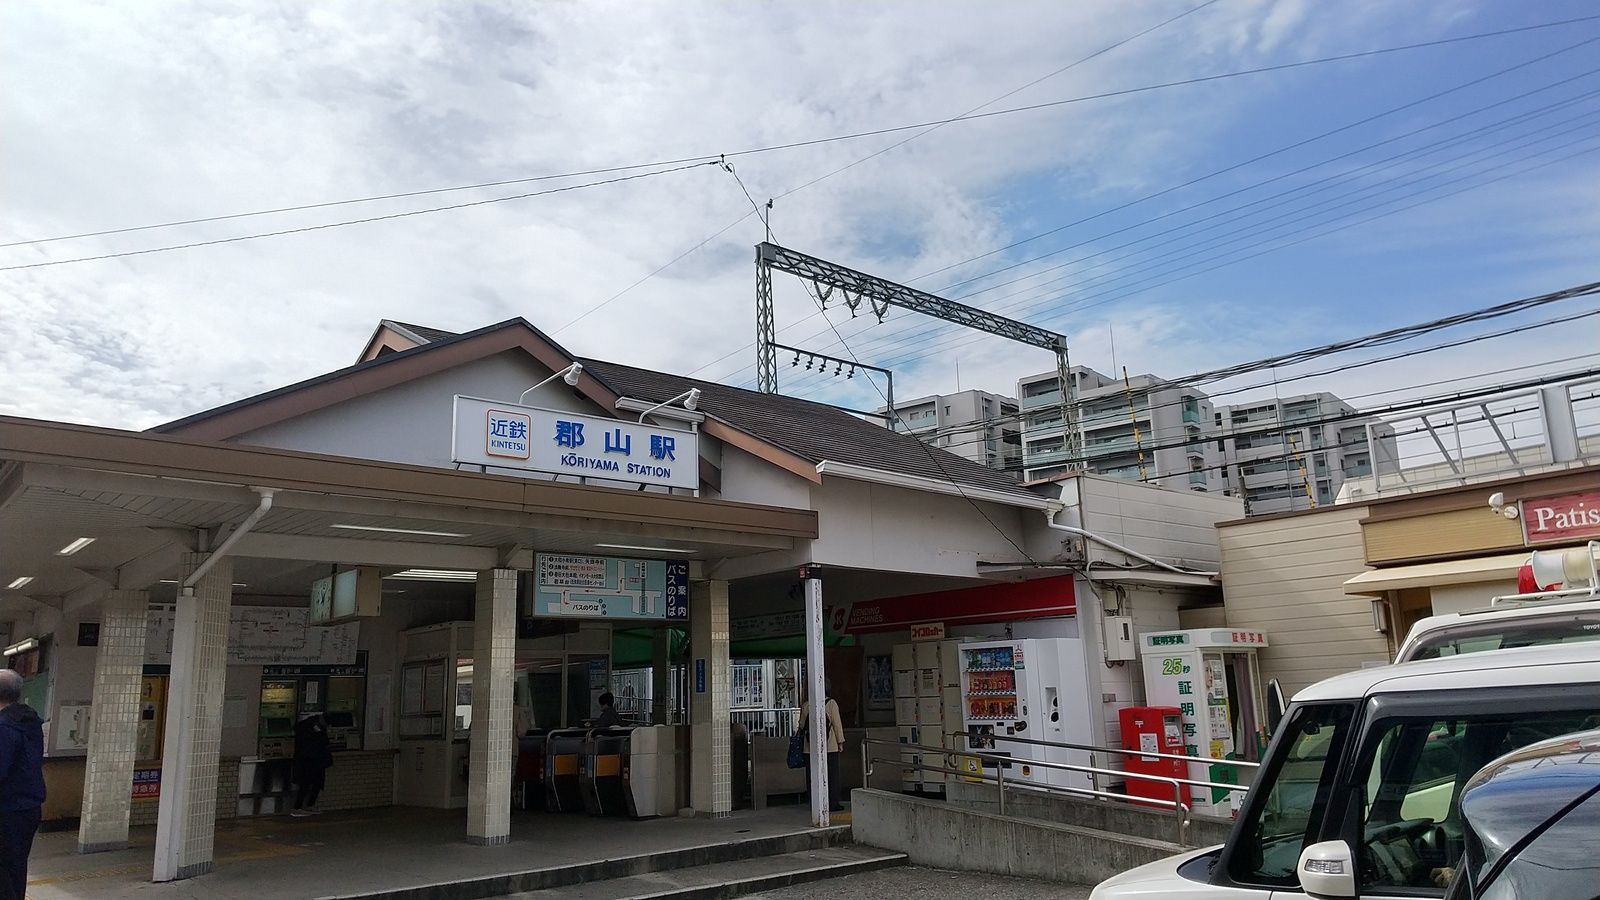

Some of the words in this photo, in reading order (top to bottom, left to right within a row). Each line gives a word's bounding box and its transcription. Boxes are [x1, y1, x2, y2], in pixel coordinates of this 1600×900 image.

[490, 417, 527, 440] 近鉄
[491, 440, 526, 452] KINTETSU
[553, 420, 676, 462] 郡山駅
[627, 463, 671, 478] STATION
[1533, 502, 1600, 531] Patis
[667, 564, 677, 617] バスのりば
[678, 564, 687, 617] ご案内
[850, 614, 884, 625] MACHINES
[852, 606, 880, 617] VENDING
[1152, 635, 1184, 645] 証明写真
[1231, 632, 1264, 643] 証明写真
[1177, 681, 1199, 757] 証明写真
